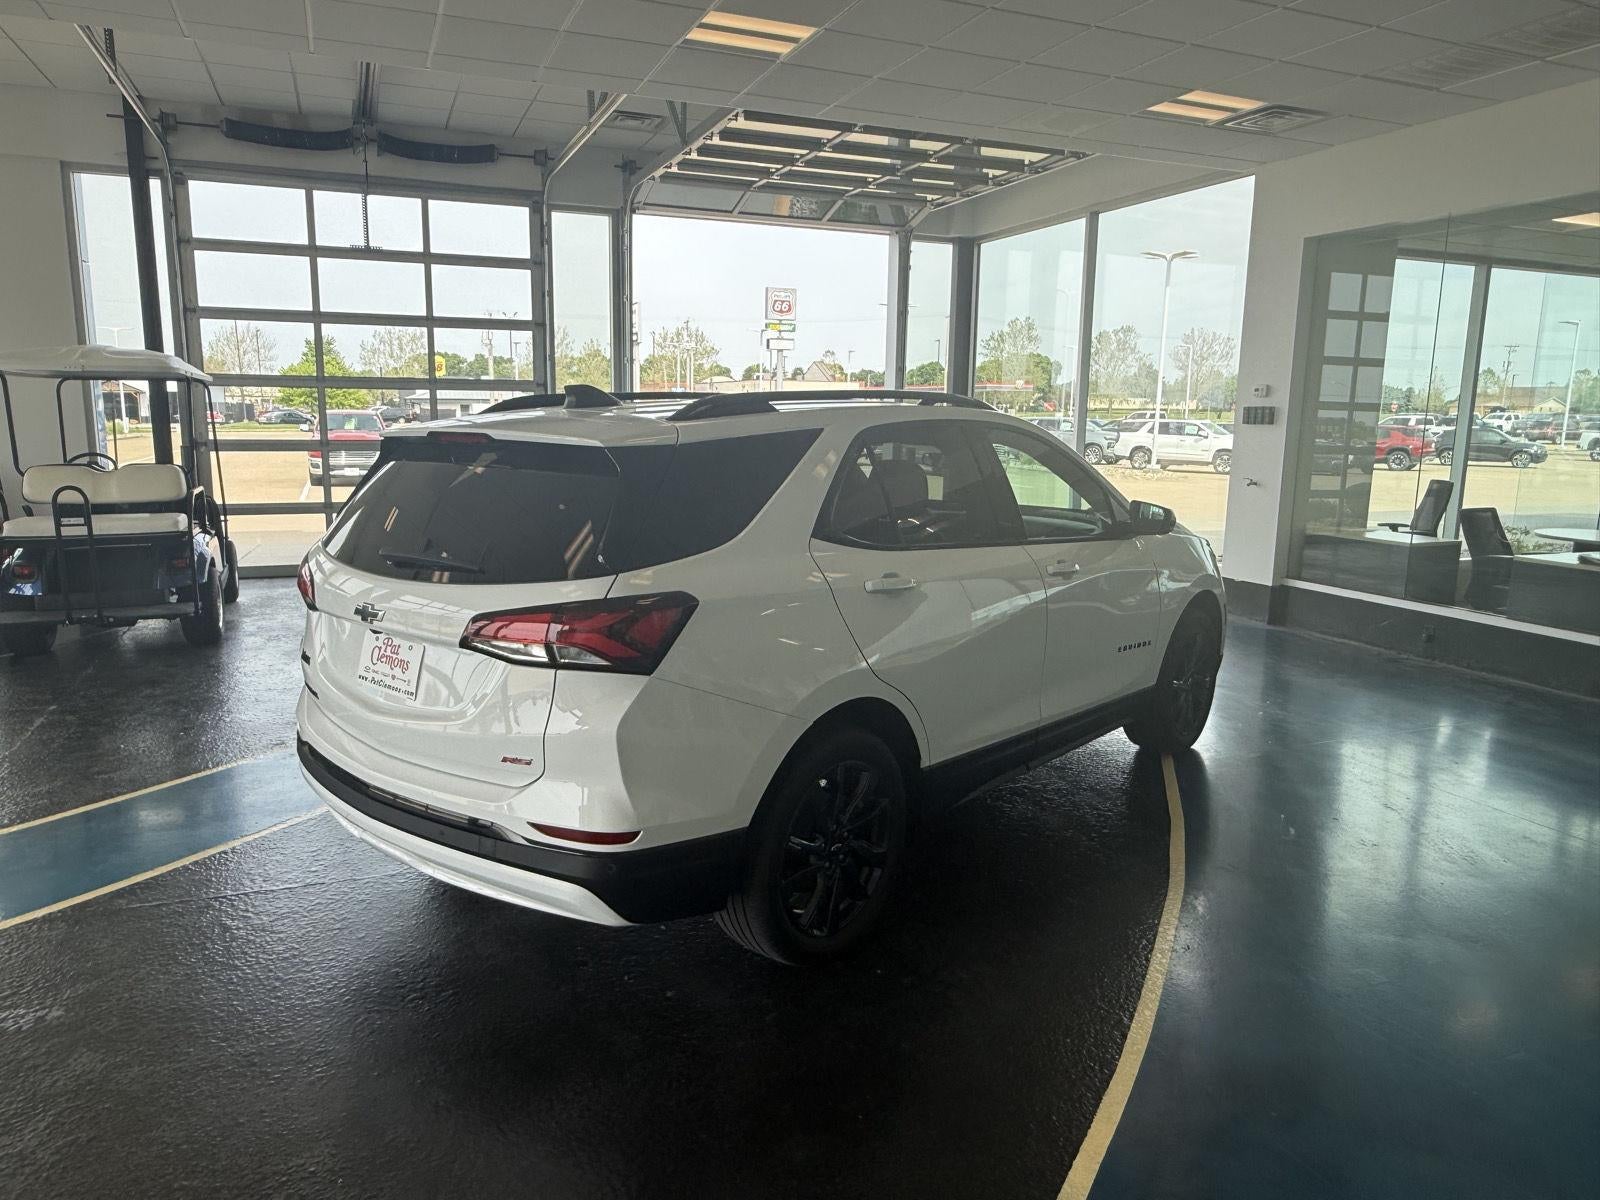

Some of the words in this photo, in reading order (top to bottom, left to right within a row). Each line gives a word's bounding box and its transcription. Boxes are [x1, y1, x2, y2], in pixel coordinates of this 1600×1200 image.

[774, 301, 790, 311] 66
[383, 637, 401, 656] Pat
[371, 645, 410, 674] Clemons
